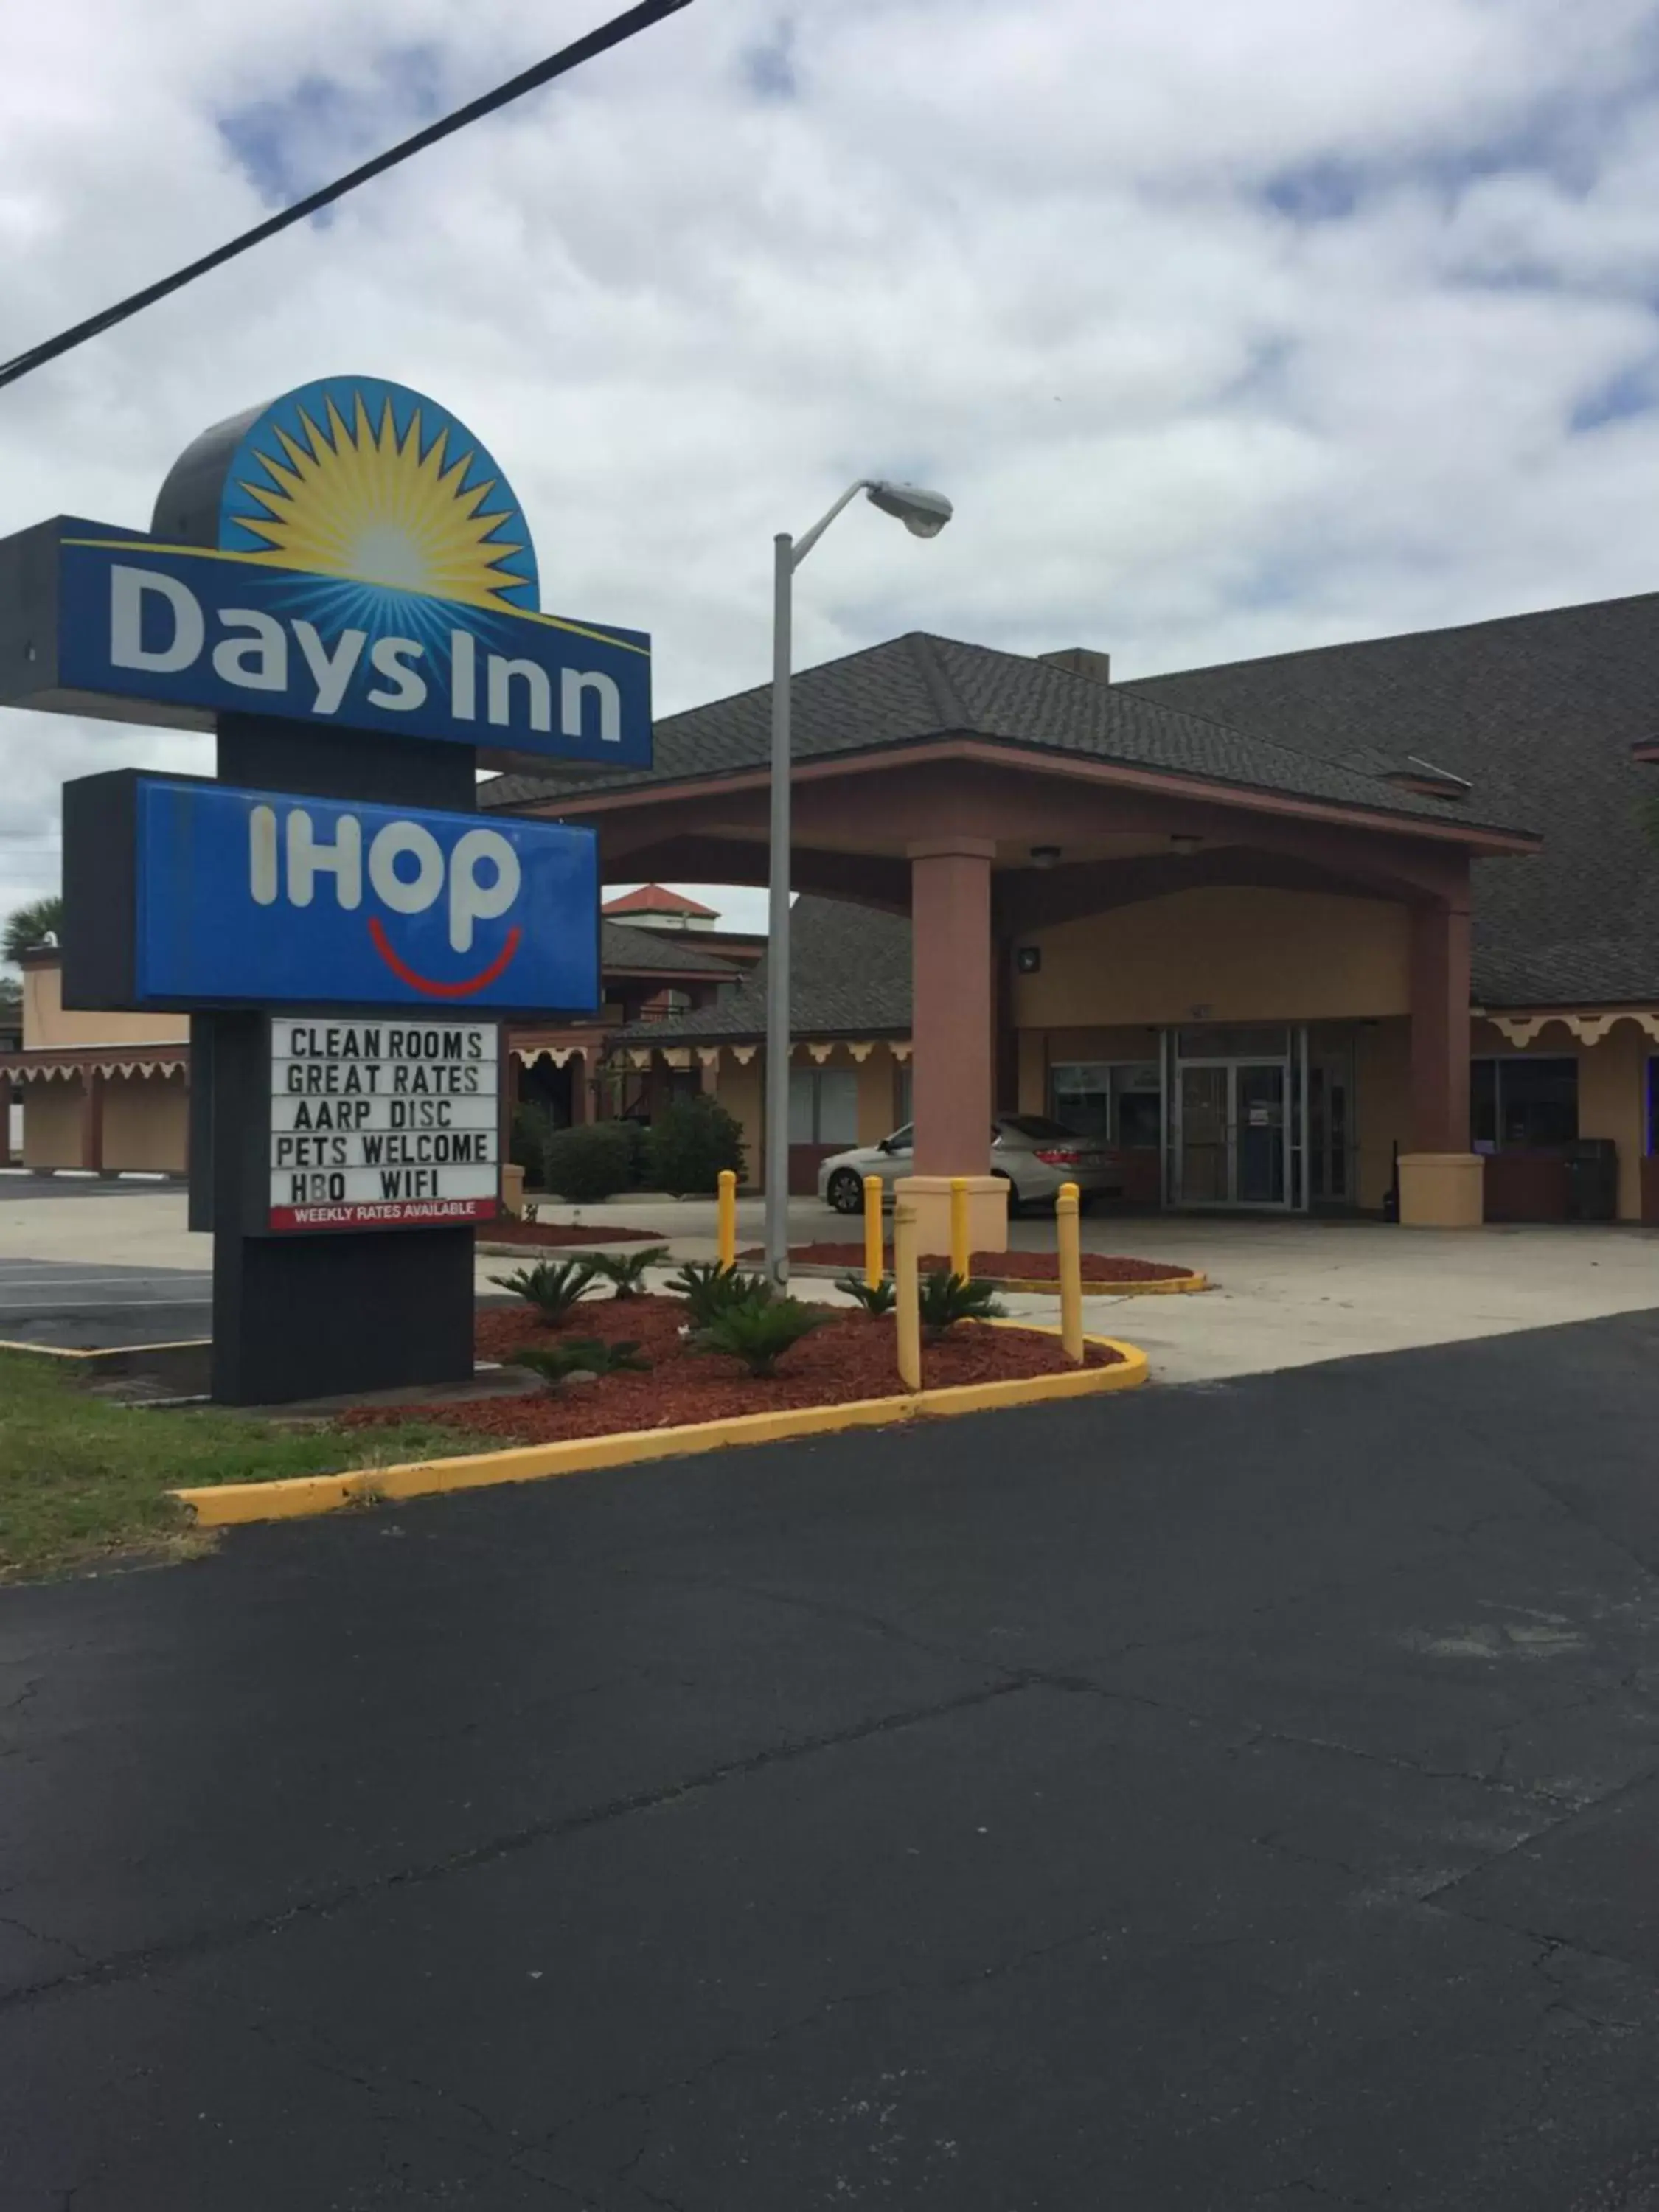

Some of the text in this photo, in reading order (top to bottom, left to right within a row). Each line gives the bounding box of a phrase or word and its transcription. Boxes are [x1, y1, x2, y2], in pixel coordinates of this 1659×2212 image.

[110, 564, 622, 742] Days Inn
[291, 1028, 482, 1060] CLEAN ROOMS
[288, 1064, 479, 1093] GREAT RATES
[293, 1100, 451, 1130] AARP DISC
[277, 1133, 487, 1166] PETS WELCOME
[292, 1169, 439, 1203] HBO WIFI
[294, 1201, 476, 1222] WEEKLY RATES AVAILABLE
